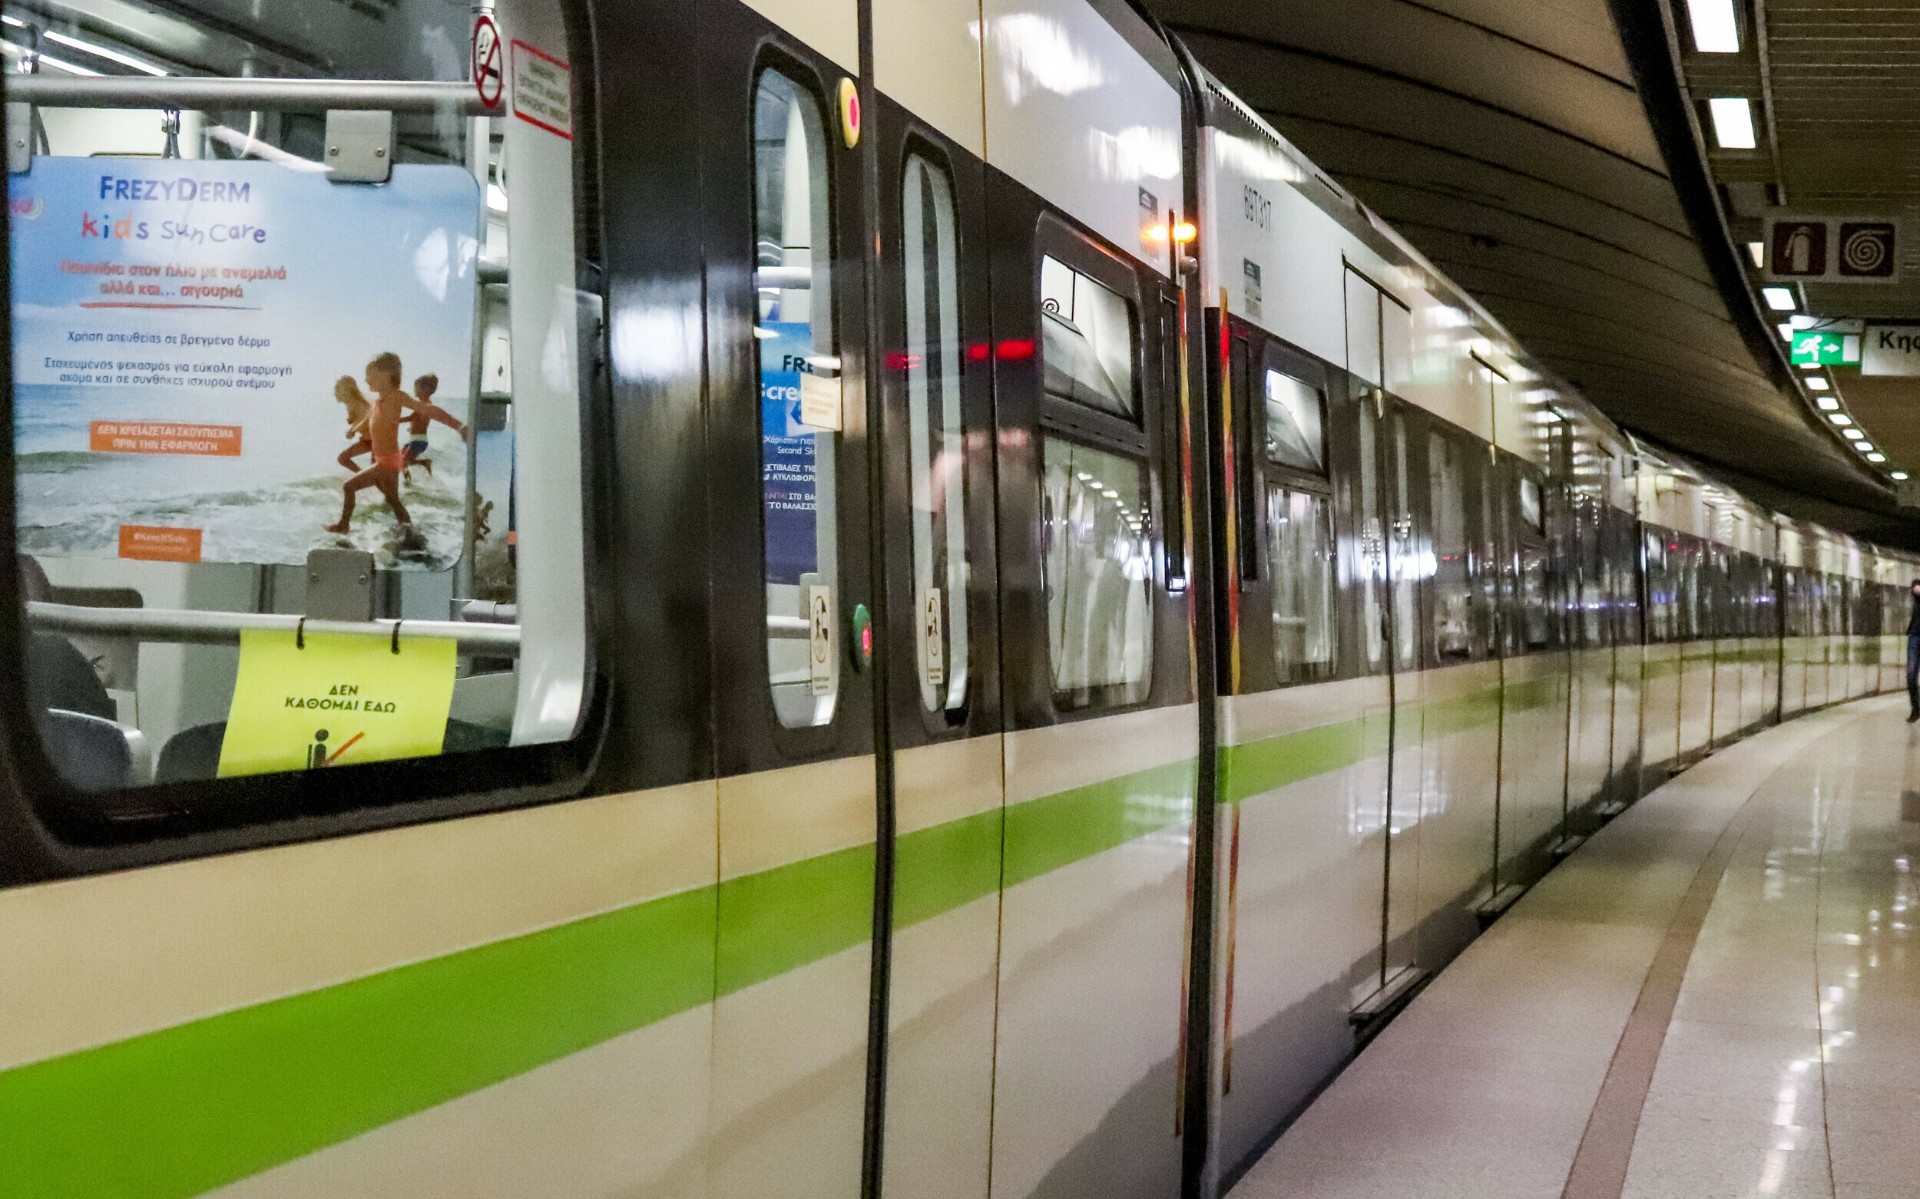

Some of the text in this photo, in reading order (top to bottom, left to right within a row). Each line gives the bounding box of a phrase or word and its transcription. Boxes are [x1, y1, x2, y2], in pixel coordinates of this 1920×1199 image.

[100, 175, 250, 203] FREZYDERM
[81, 209, 149, 240] kids
[222, 265, 287, 282] ανεμελιά
[180, 284, 244, 300] σιγουριά
[67, 330, 103, 343] Χρήση
[106, 331, 162, 345] απευθείας
[164, 335, 178, 345] σε
[237, 335, 271, 349] δέρμα
[116, 358, 171, 372] ψεκασμός
[173, 361, 190, 374] για
[192, 360, 235, 374] εύκολη
[237, 363, 293, 378] εφαρμογή
[95, 373, 113, 385] και
[116, 374, 130, 385] σε
[761, 383, 801, 401] cre
[97, 425, 118, 435] ΔΕΝ
[777, 446, 802, 455] Second
[788, 492, 802, 500] ΣΤΟ
[329, 684, 359, 696] ΔΕΝ
[284, 697, 396, 713] ΚΑΘΟΜΑΙ ΕΔΩ
